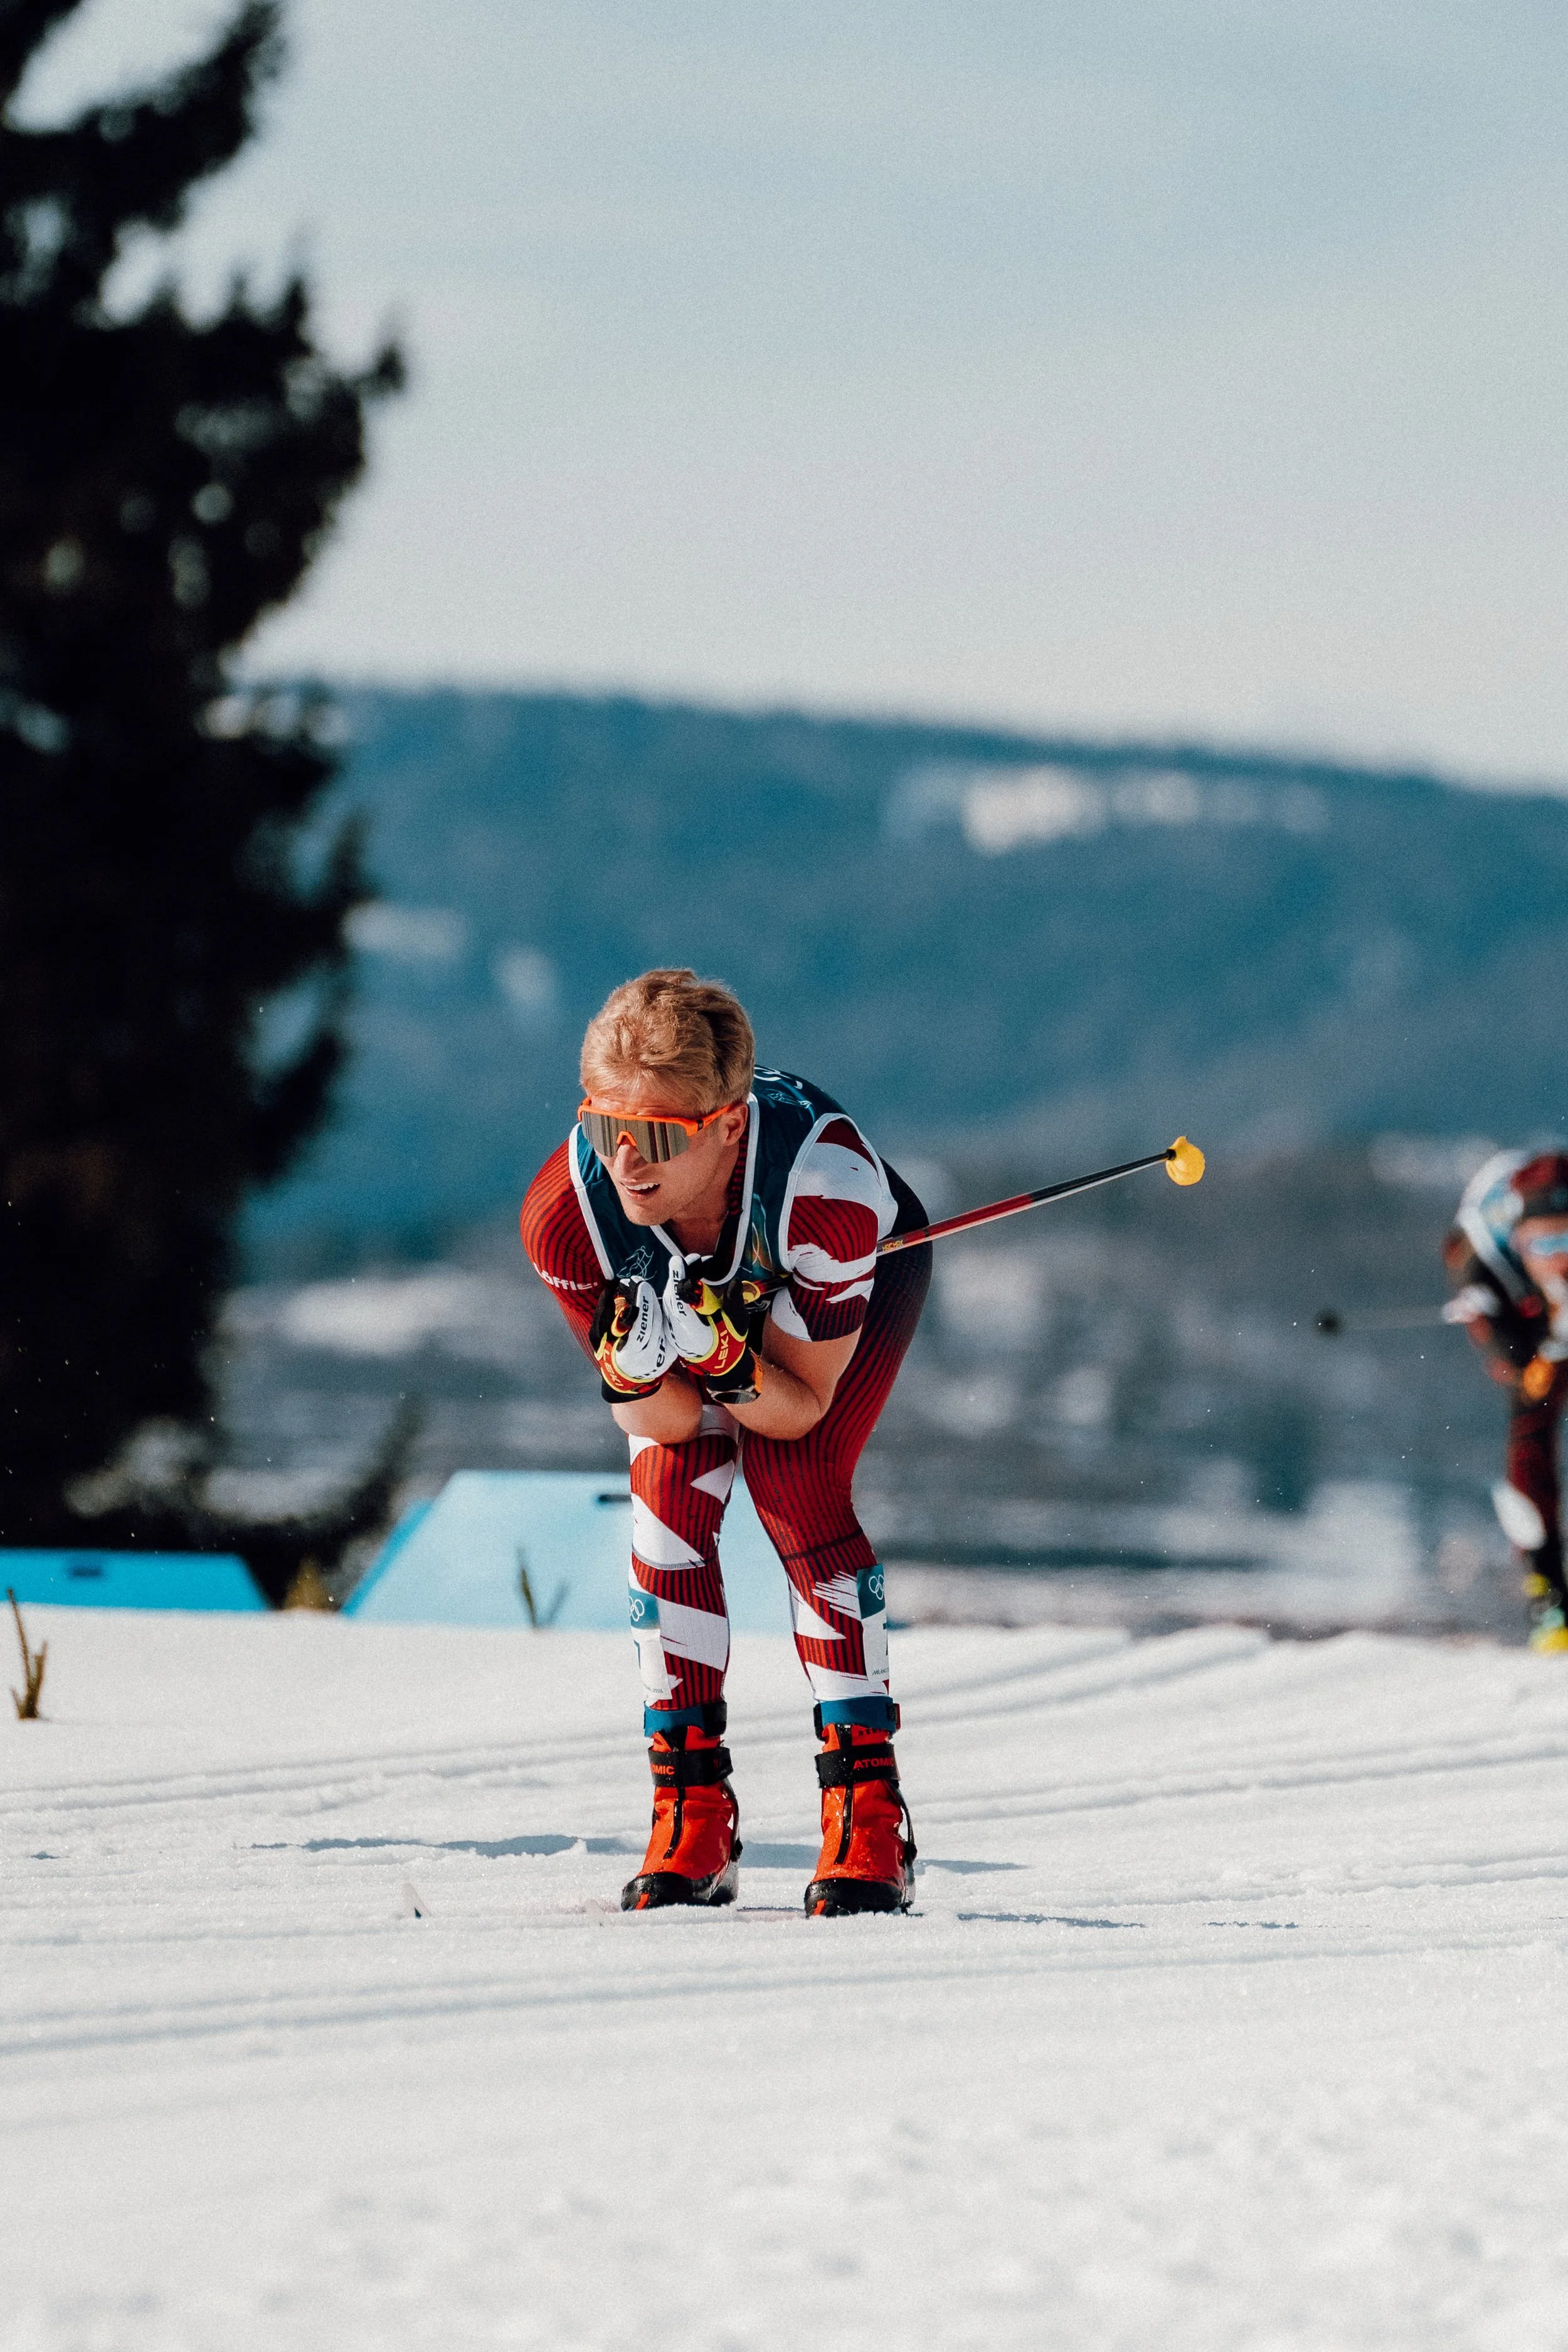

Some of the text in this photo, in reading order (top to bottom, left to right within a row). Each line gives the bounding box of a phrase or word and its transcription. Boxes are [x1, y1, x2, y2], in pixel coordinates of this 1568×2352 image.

[637, 1296, 649, 1342] ziener
[603, 1349, 623, 1386] LEKI
[714, 1330, 729, 1369] LEKI
[650, 1764, 675, 1775] OMIC
